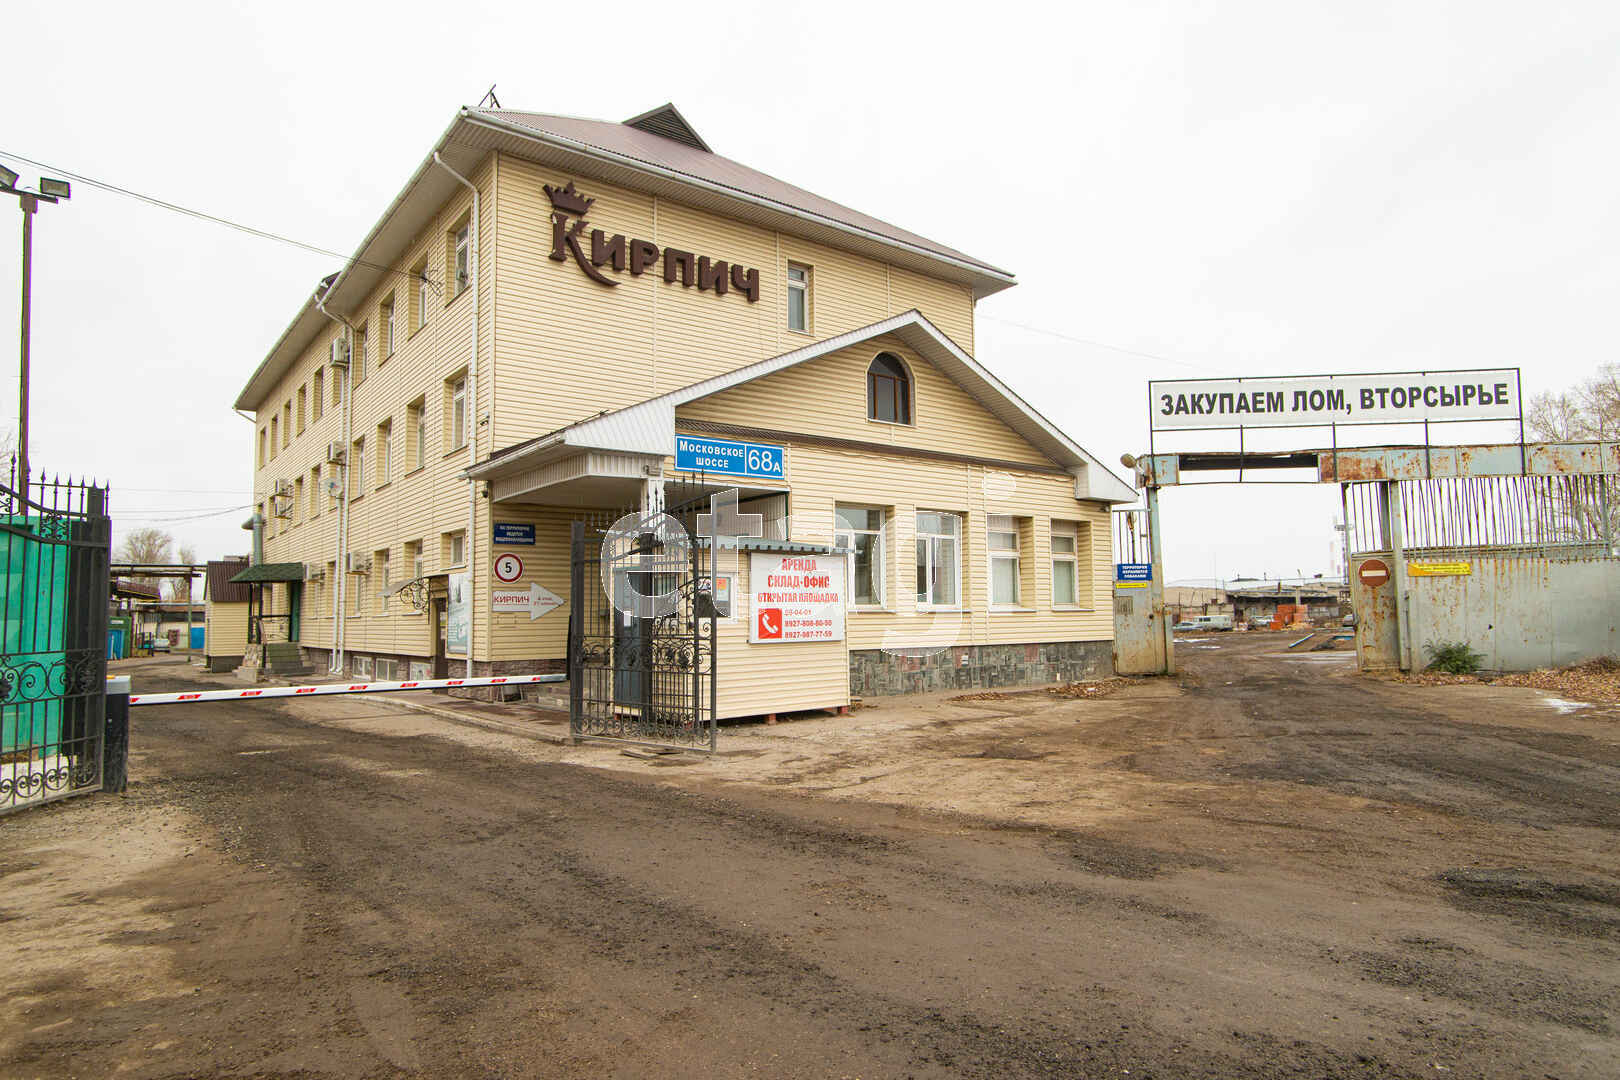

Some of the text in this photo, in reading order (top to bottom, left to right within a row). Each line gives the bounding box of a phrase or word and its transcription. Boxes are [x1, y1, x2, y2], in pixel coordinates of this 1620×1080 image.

[1160, 383, 1509, 416] ЗАКУПАЕМ ЛОМ, ВТОРСЫРЬЕ
[504, 562, 513, 573] 5
[781, 557, 817, 572] АРЕНДА
[757, 592, 839, 604] ОТКРЫТАЯ ПЛОЩАДКА
